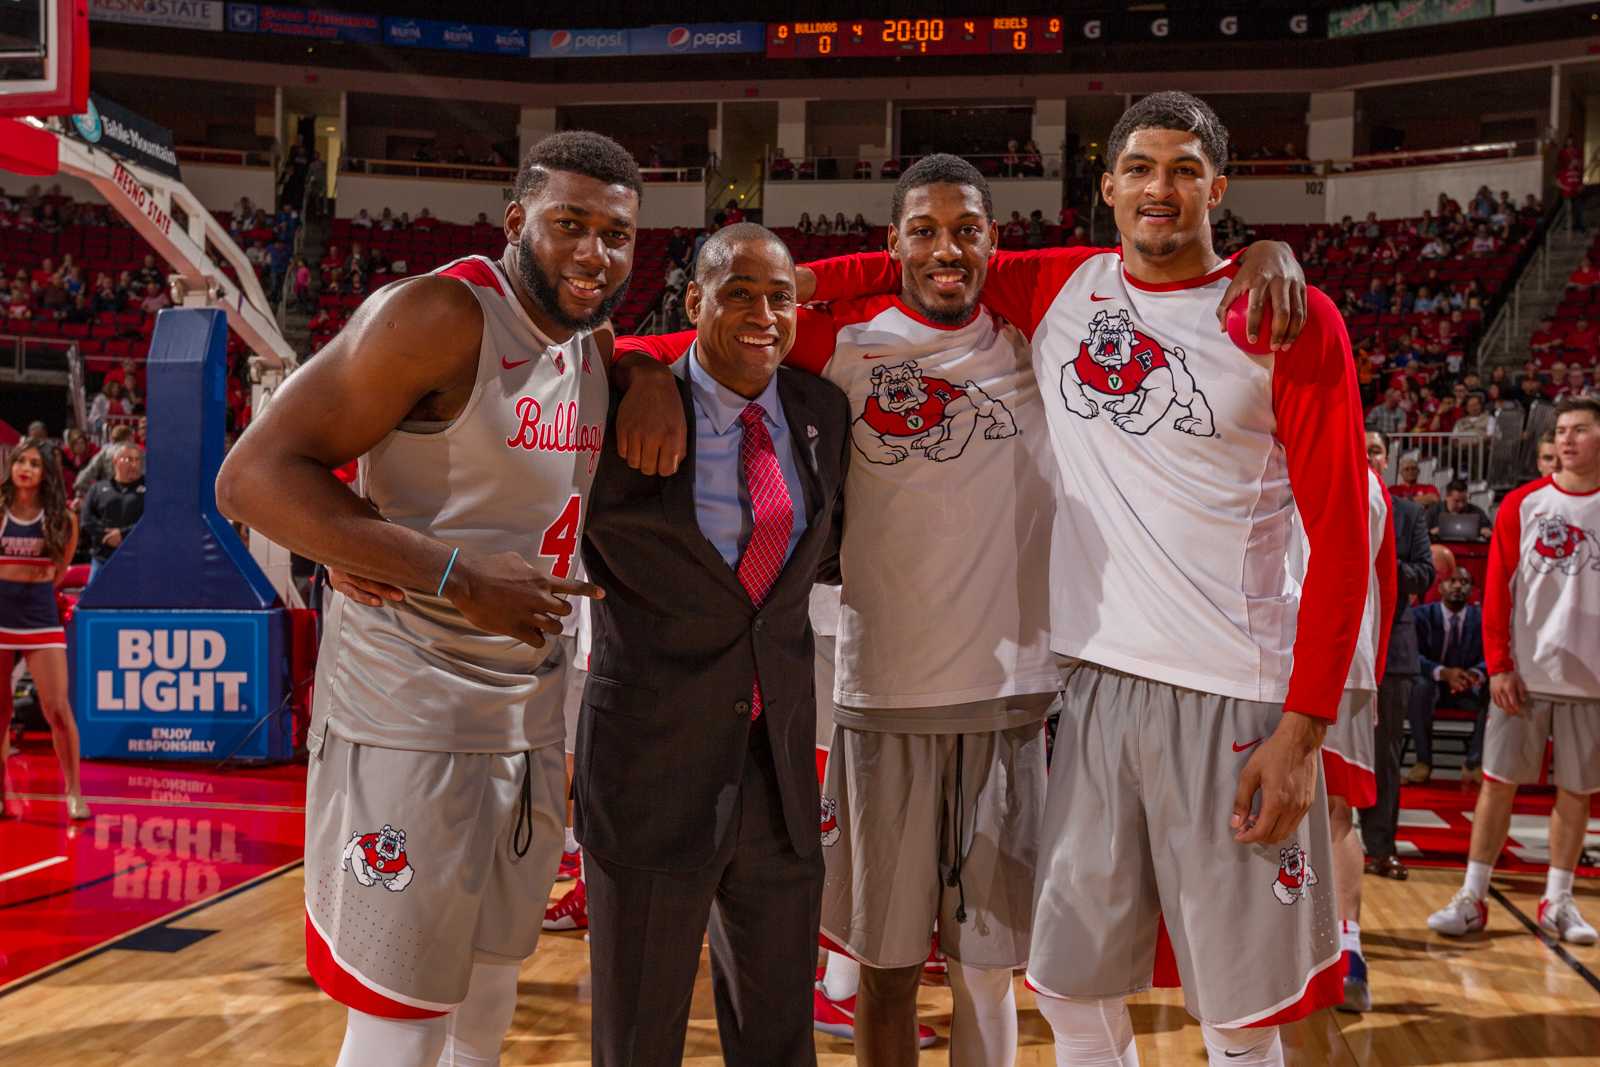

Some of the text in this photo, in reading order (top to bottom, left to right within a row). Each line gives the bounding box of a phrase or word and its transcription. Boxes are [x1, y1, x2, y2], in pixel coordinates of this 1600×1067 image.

[160, 1, 210, 18] STATE
[778, 25, 788, 39] 0
[852, 24, 863, 36] 4
[882, 20, 944, 41] 20:00
[964, 21, 975, 33] 4
[993, 17, 1028, 30] REBELS
[1049, 18, 1060, 33] 0
[575, 30, 623, 49] pepsi
[693, 29, 742, 47] pepsi
[819, 35, 831, 53] 0
[1013, 31, 1026, 50] 0
[100, 115, 177, 166] Table Mountain
[1305, 181, 1325, 195] 102
[112, 160, 171, 235] FRESNO STATE
[538, 493, 581, 580] 4
[117, 629, 227, 670] BUD
[97, 670, 248, 712] LIGHT
[151, 728, 192, 740] ENJOY
[128, 739, 216, 752] RESPONSIBLY
